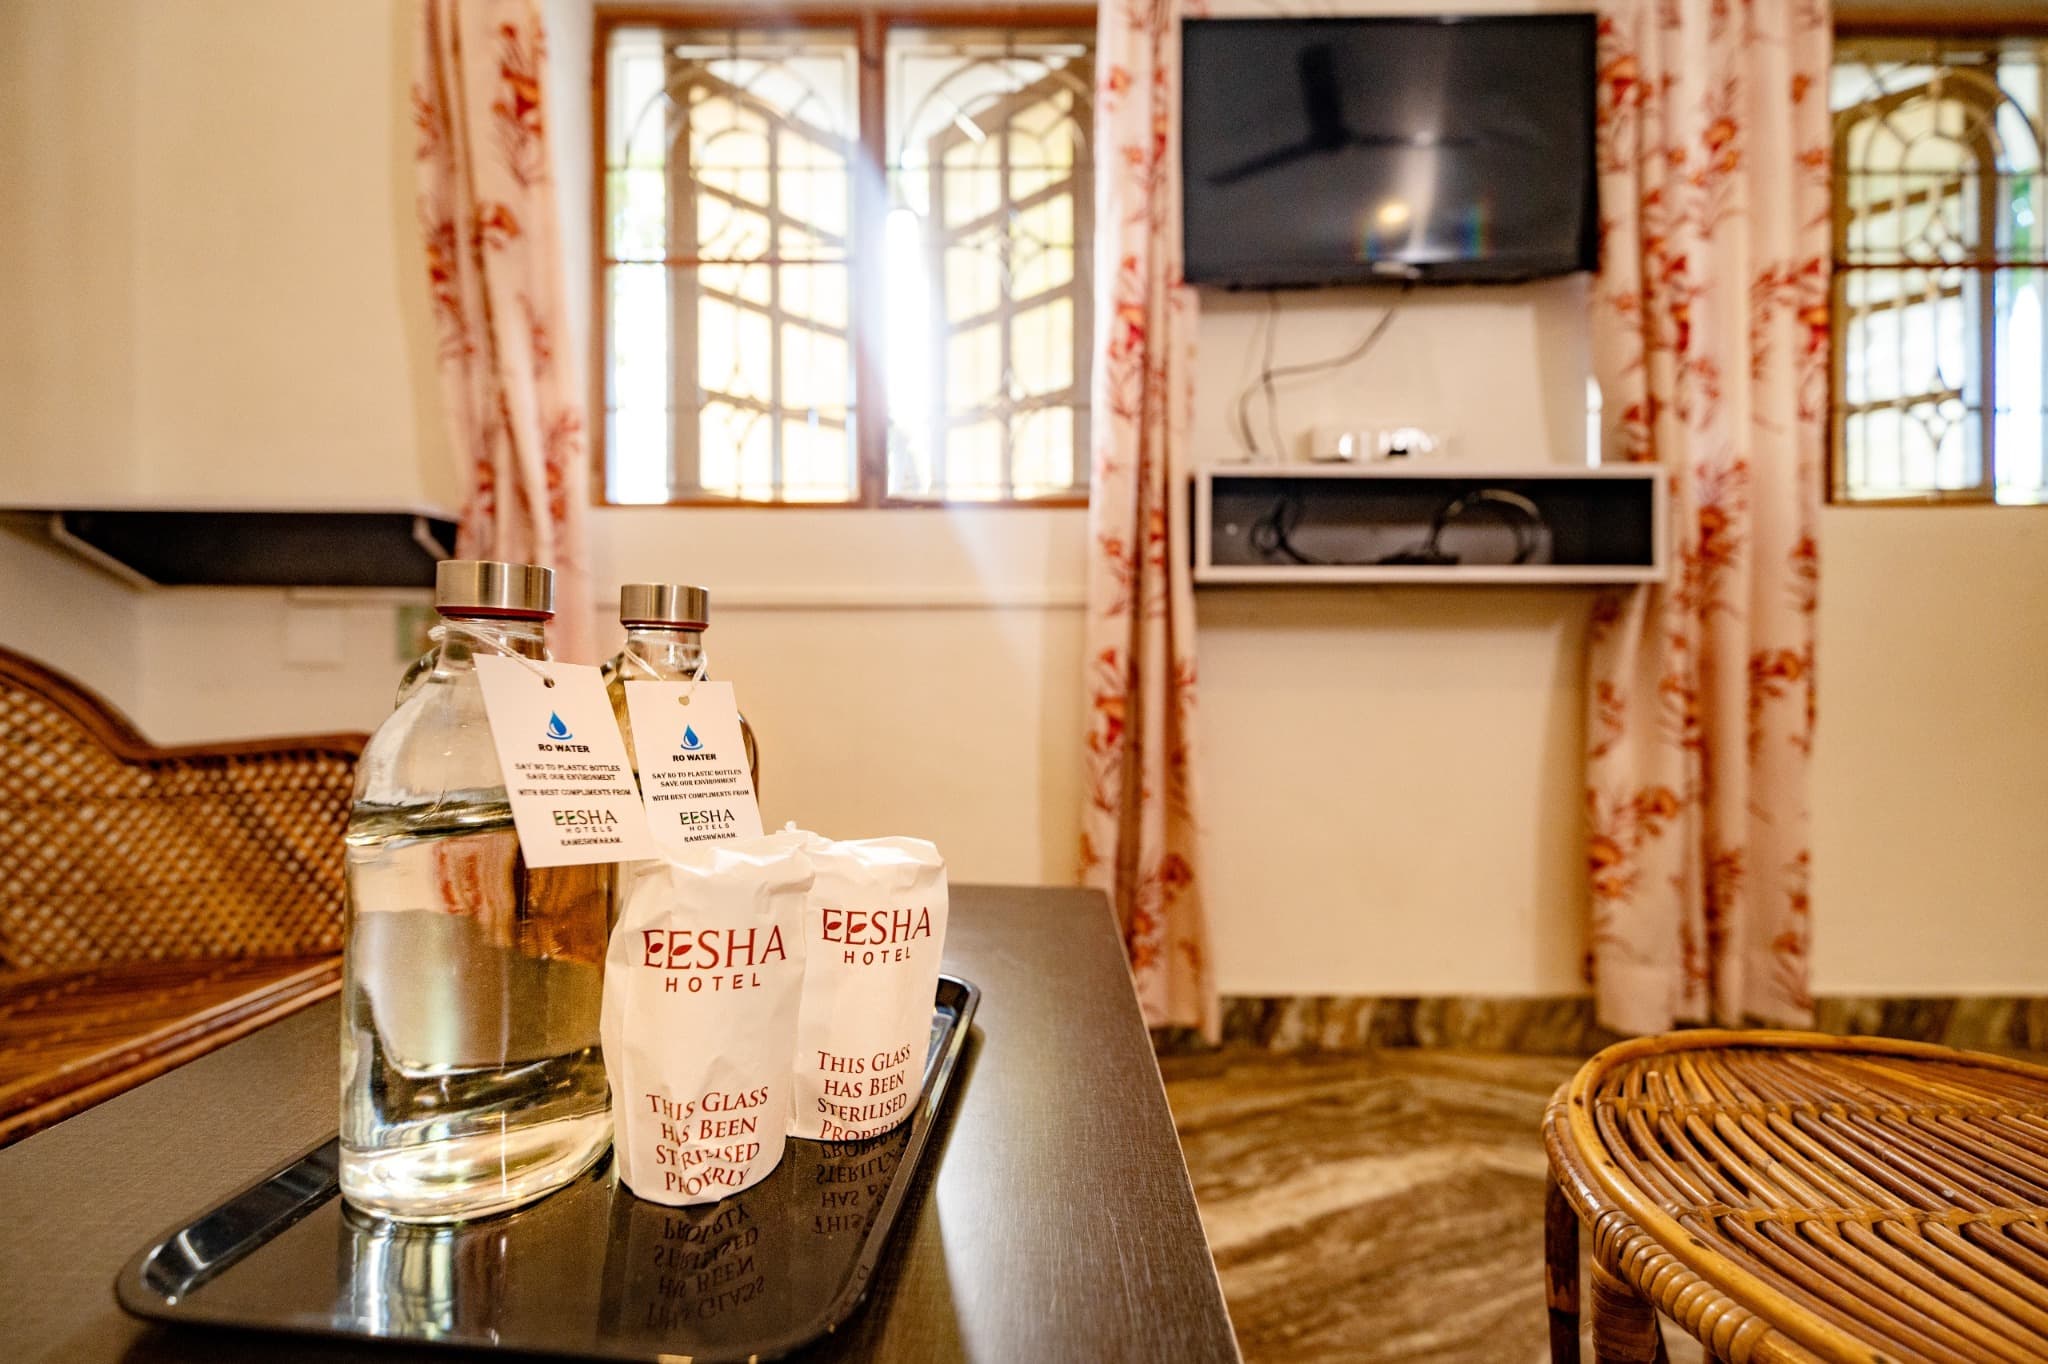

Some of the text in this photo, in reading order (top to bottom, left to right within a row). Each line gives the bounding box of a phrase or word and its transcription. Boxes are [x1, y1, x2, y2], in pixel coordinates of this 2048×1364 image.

[538, 744, 591, 753] RO WATER
[672, 753, 717, 762] RO WATER
[566, 773, 616, 781] ENVIRONMENT
[589, 764, 621, 772] BOTTLES
[694, 777, 737, 785] ENVIRONMENT
[652, 794, 669, 802] WITH
[688, 791, 732, 799] COMPLIMENTS
[552, 809, 619, 826] EESHA
[679, 808, 736, 825] EESHA
[689, 822, 730, 831] HOTELS
[565, 826, 613, 834] HOTELS
[821, 906, 931, 945] EESHA
[641, 924, 787, 970] EESHA
[843, 946, 911, 966] HOTEL
[665, 972, 761, 993] HOTEL
[817, 1043, 911, 1074] THIS GLASS
[823, 1070, 905, 1098] HAS BEEN
[646, 1086, 769, 1121] THIS GLASS
[817, 1092, 907, 1122] STERILISED
[699, 1116, 758, 1140] BEEN
[656, 1142, 760, 1171] STRILISED
[664, 1167, 751, 1196] PRORLY
